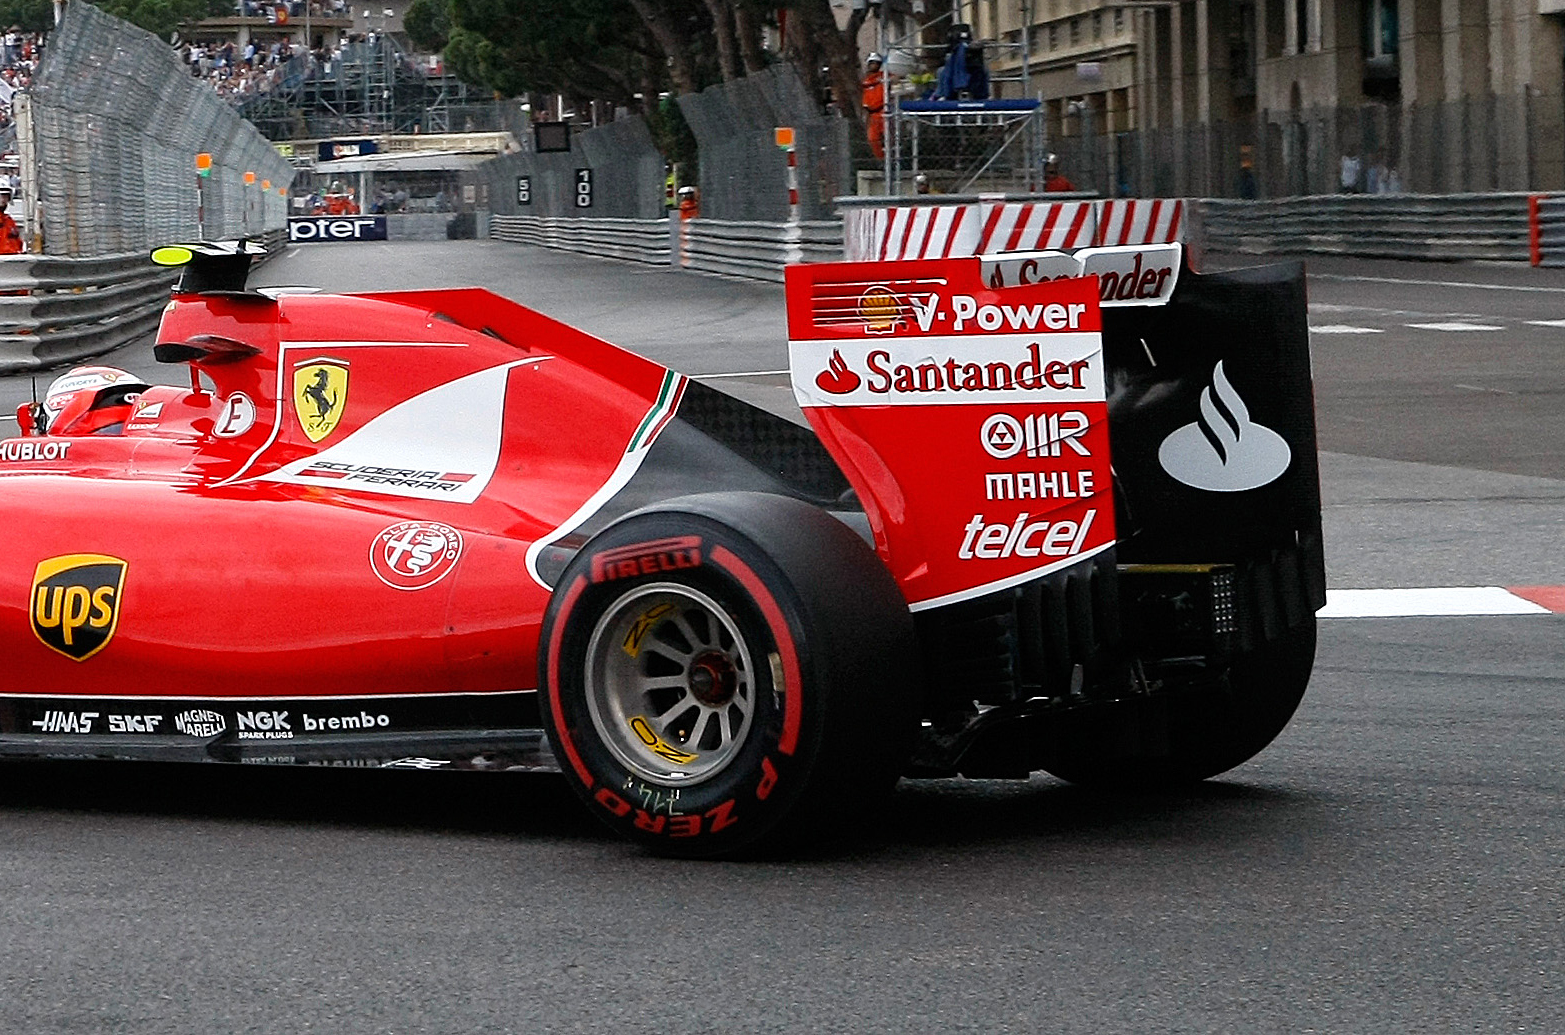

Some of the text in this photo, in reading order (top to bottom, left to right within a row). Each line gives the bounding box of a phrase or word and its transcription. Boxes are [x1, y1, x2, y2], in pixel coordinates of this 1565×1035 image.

[519, 179, 529, 202] 50
[578, 170, 591, 206] 100
[1019, 252, 1172, 301] Snder
[866, 342, 1090, 393] Santander
[308, 461, 440, 480] SCUDERIA
[347, 473, 462, 492] FERRARI
[985, 471, 1095, 500] MAHLE
[382, 523, 459, 560] ALFA ROMEO
[958, 509, 1097, 559] telcel
[591, 534, 703, 583] PIRELLI
[36, 584, 115, 646] ups
[108, 714, 163, 733] SKF
[236, 711, 292, 731] NGK
[238, 731, 294, 740] SPARK PLUGS
[302, 711, 390, 731] brembo
[594, 786, 739, 838] ZERO
